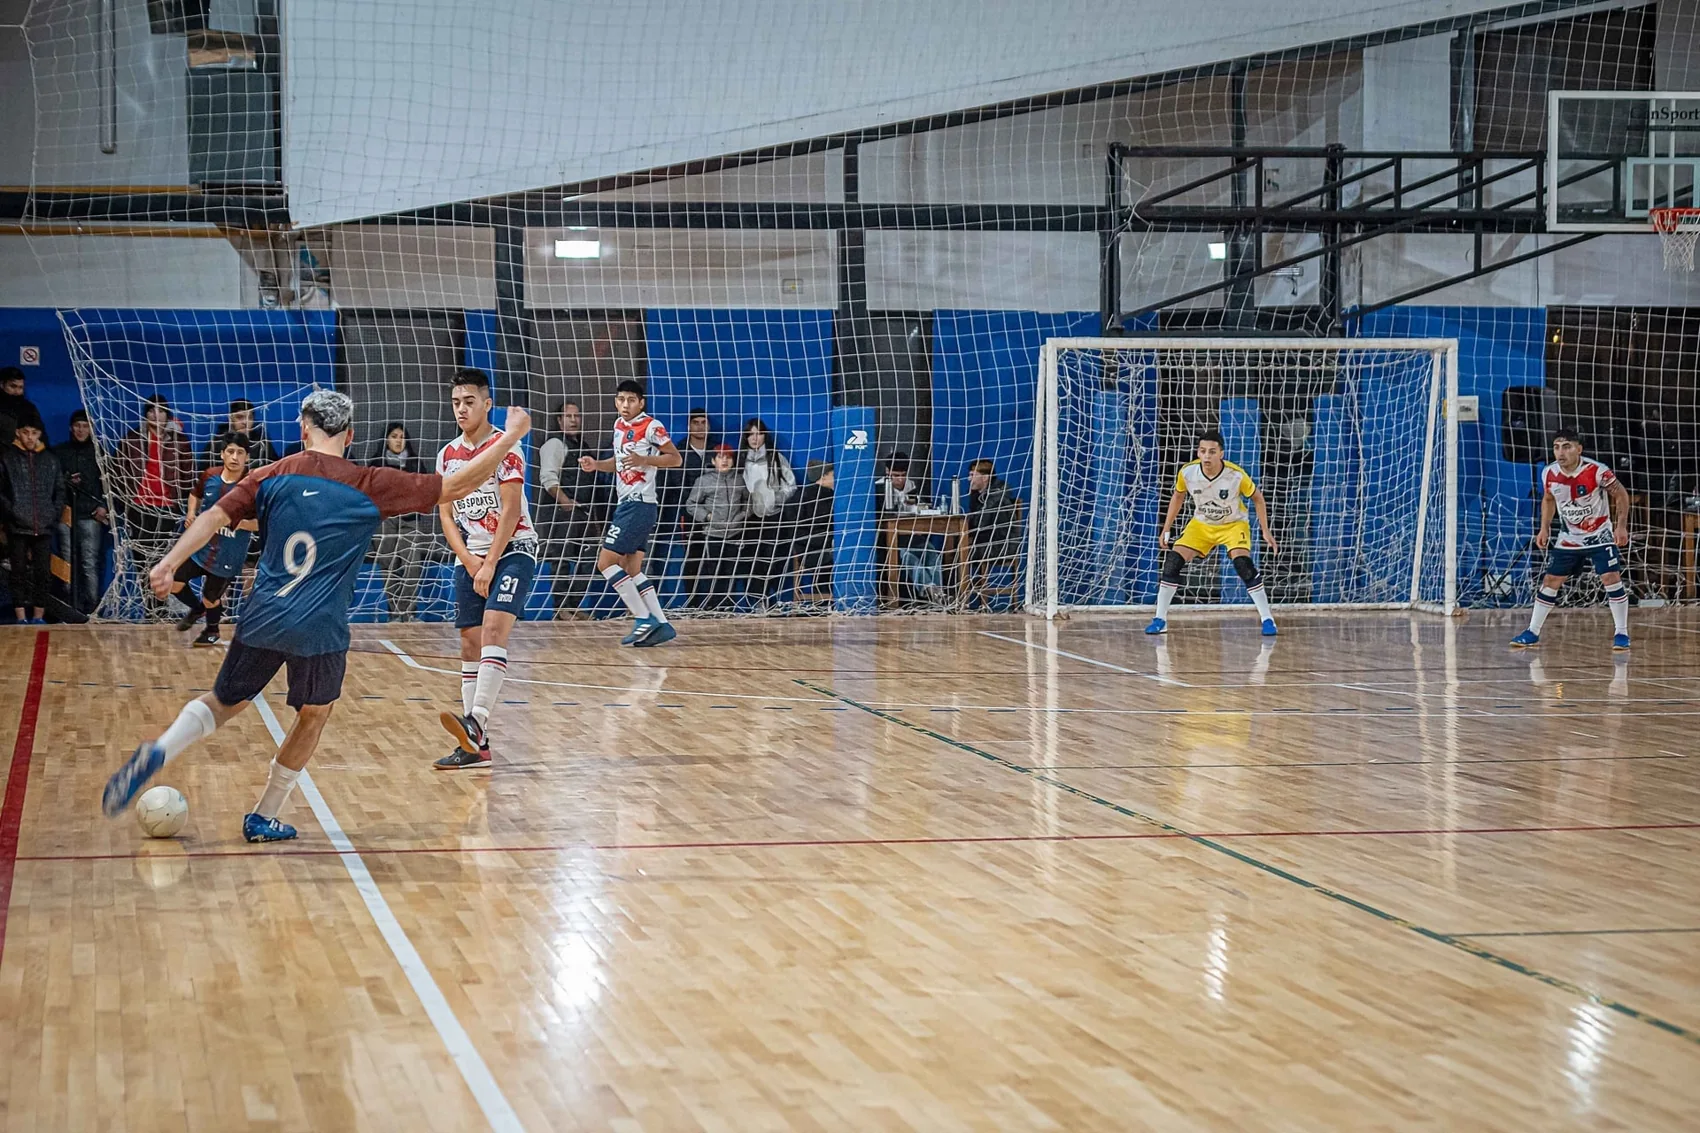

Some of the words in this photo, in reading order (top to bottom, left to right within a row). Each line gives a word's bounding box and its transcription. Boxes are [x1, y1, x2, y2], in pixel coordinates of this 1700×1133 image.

[466, 496, 494, 507] SPORTS
[1568, 506, 1591, 516] SPORTS
[607, 524, 621, 539] 22
[1605, 546, 1614, 558] 7
[273, 530, 318, 598] 9
[500, 575, 519, 594] 31
